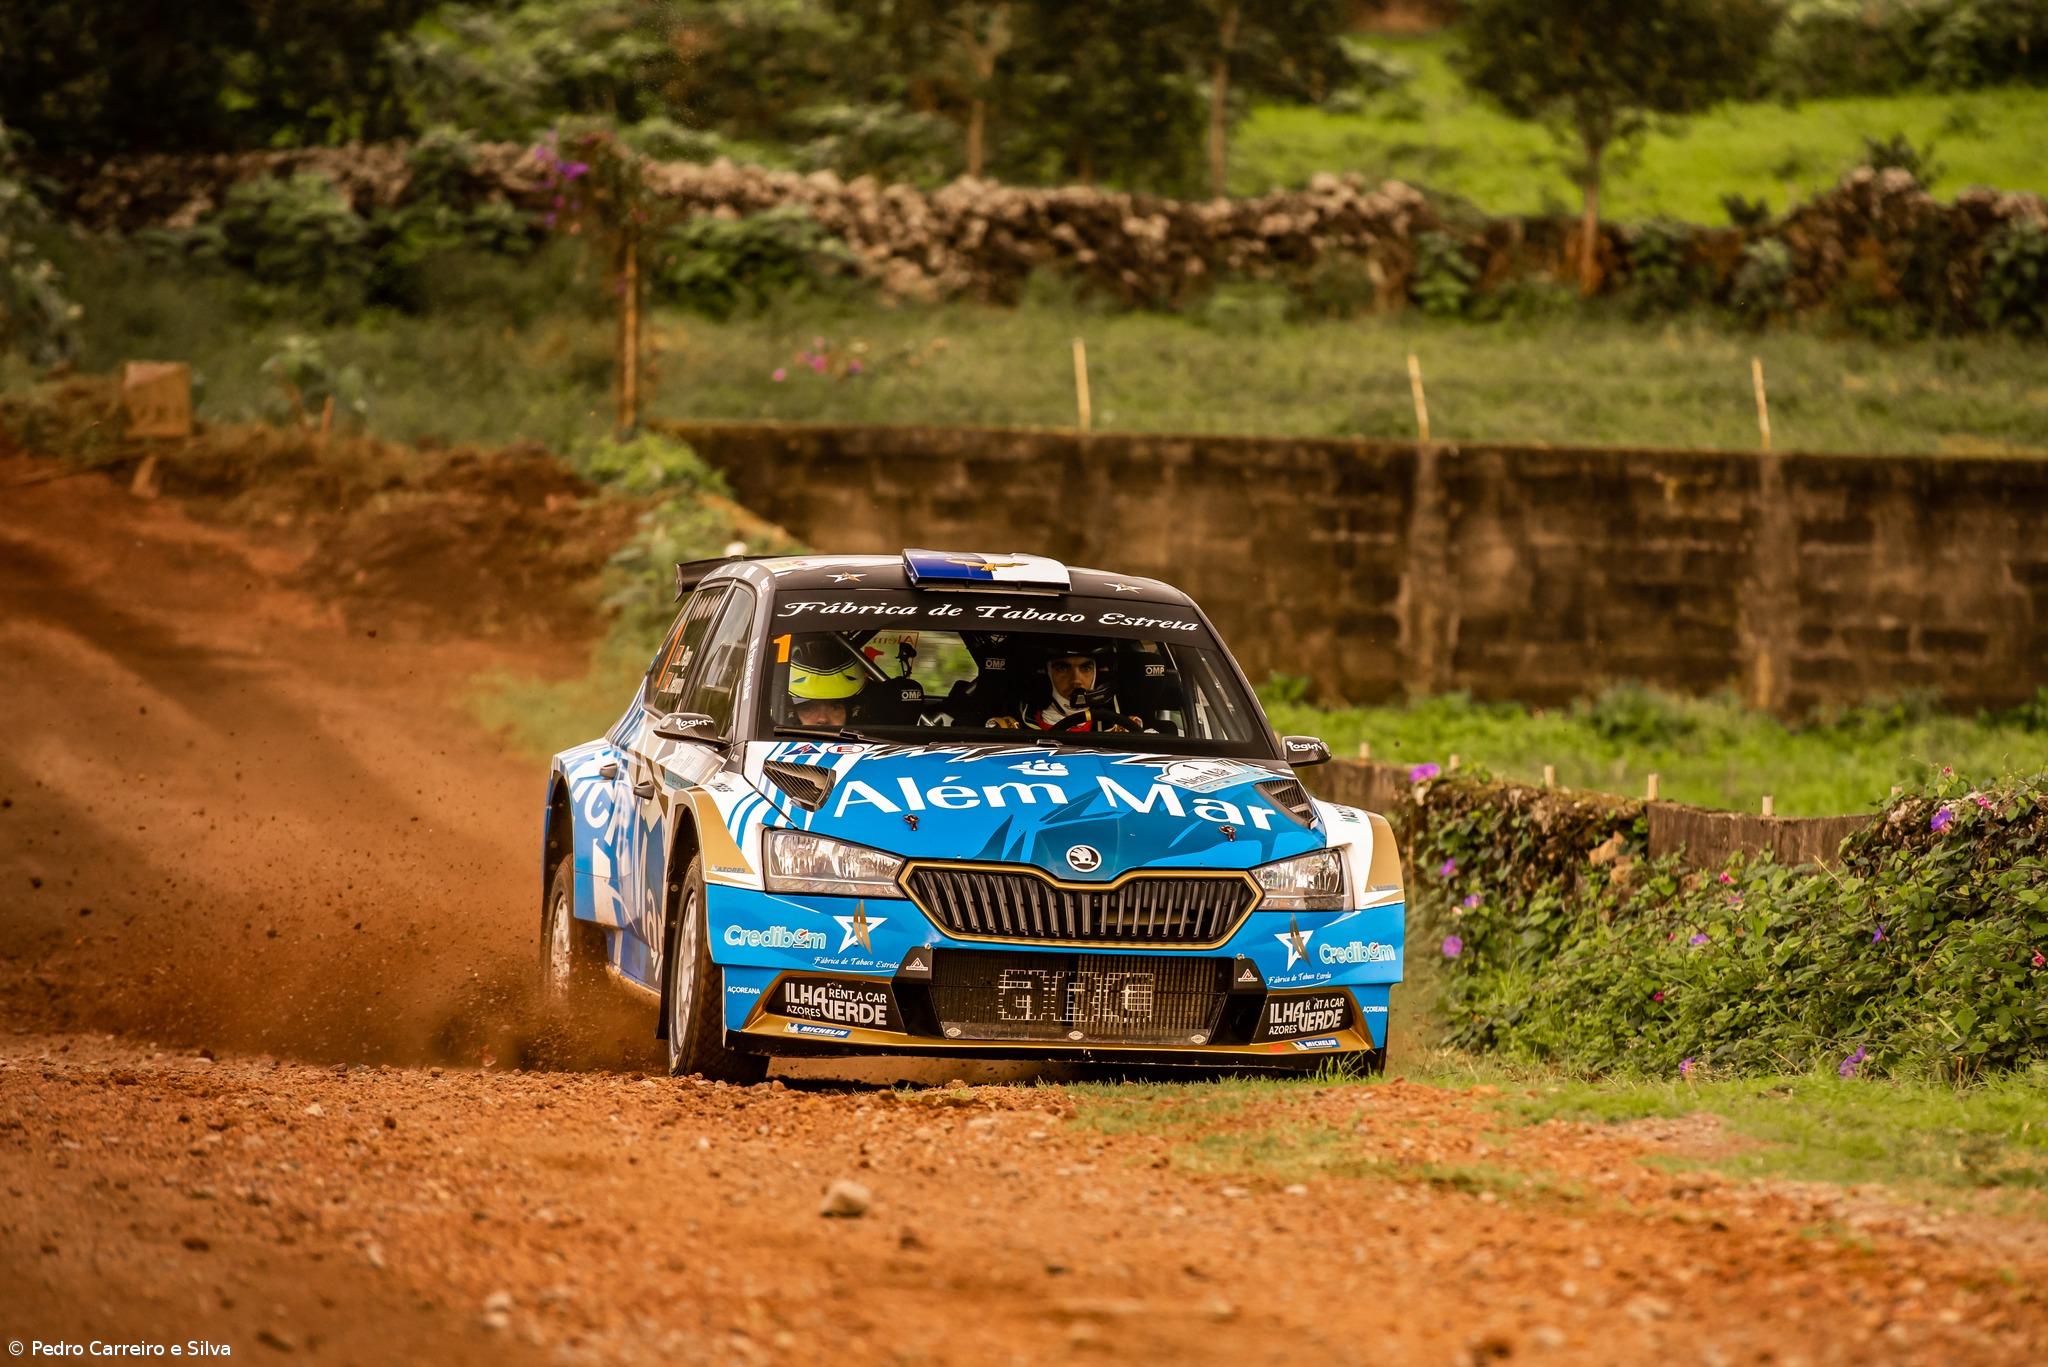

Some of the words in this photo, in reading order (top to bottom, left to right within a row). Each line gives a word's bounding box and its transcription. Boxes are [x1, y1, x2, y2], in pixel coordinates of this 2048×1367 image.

[777, 601, 917, 617] Fábrica
[928, 603, 963, 616] de
[976, 605, 1085, 623] Tabaco
[773, 634, 791, 663] 1
[985, 659, 1005, 668] OMP
[1145, 666, 1165, 675] OMP
[901, 691, 922, 700] OMP
[833, 776, 1069, 818] Além
[1096, 776, 1277, 831] Mar
[724, 924, 827, 949] Credibom
[1319, 941, 1396, 964] Credibom
[851, 957, 874, 966] Tabaco
[876, 960, 899, 968] Estrela
[727, 985, 761, 995] AÇOREANA
[785, 982, 826, 1006] ILHA
[829, 987, 855, 1000] RENT
[856, 991, 864, 1001] A
[866, 992, 887, 1003] CAR
[786, 1005, 821, 1017] AZORES
[1269, 1001, 1303, 1024] ILHA
[1330, 997, 1345, 1008] CAR
[800, 1025, 848, 1036] MICHELIN
[1268, 1024, 1297, 1035] AZORES
[1305, 1038, 1337, 1047] MICHELIN
